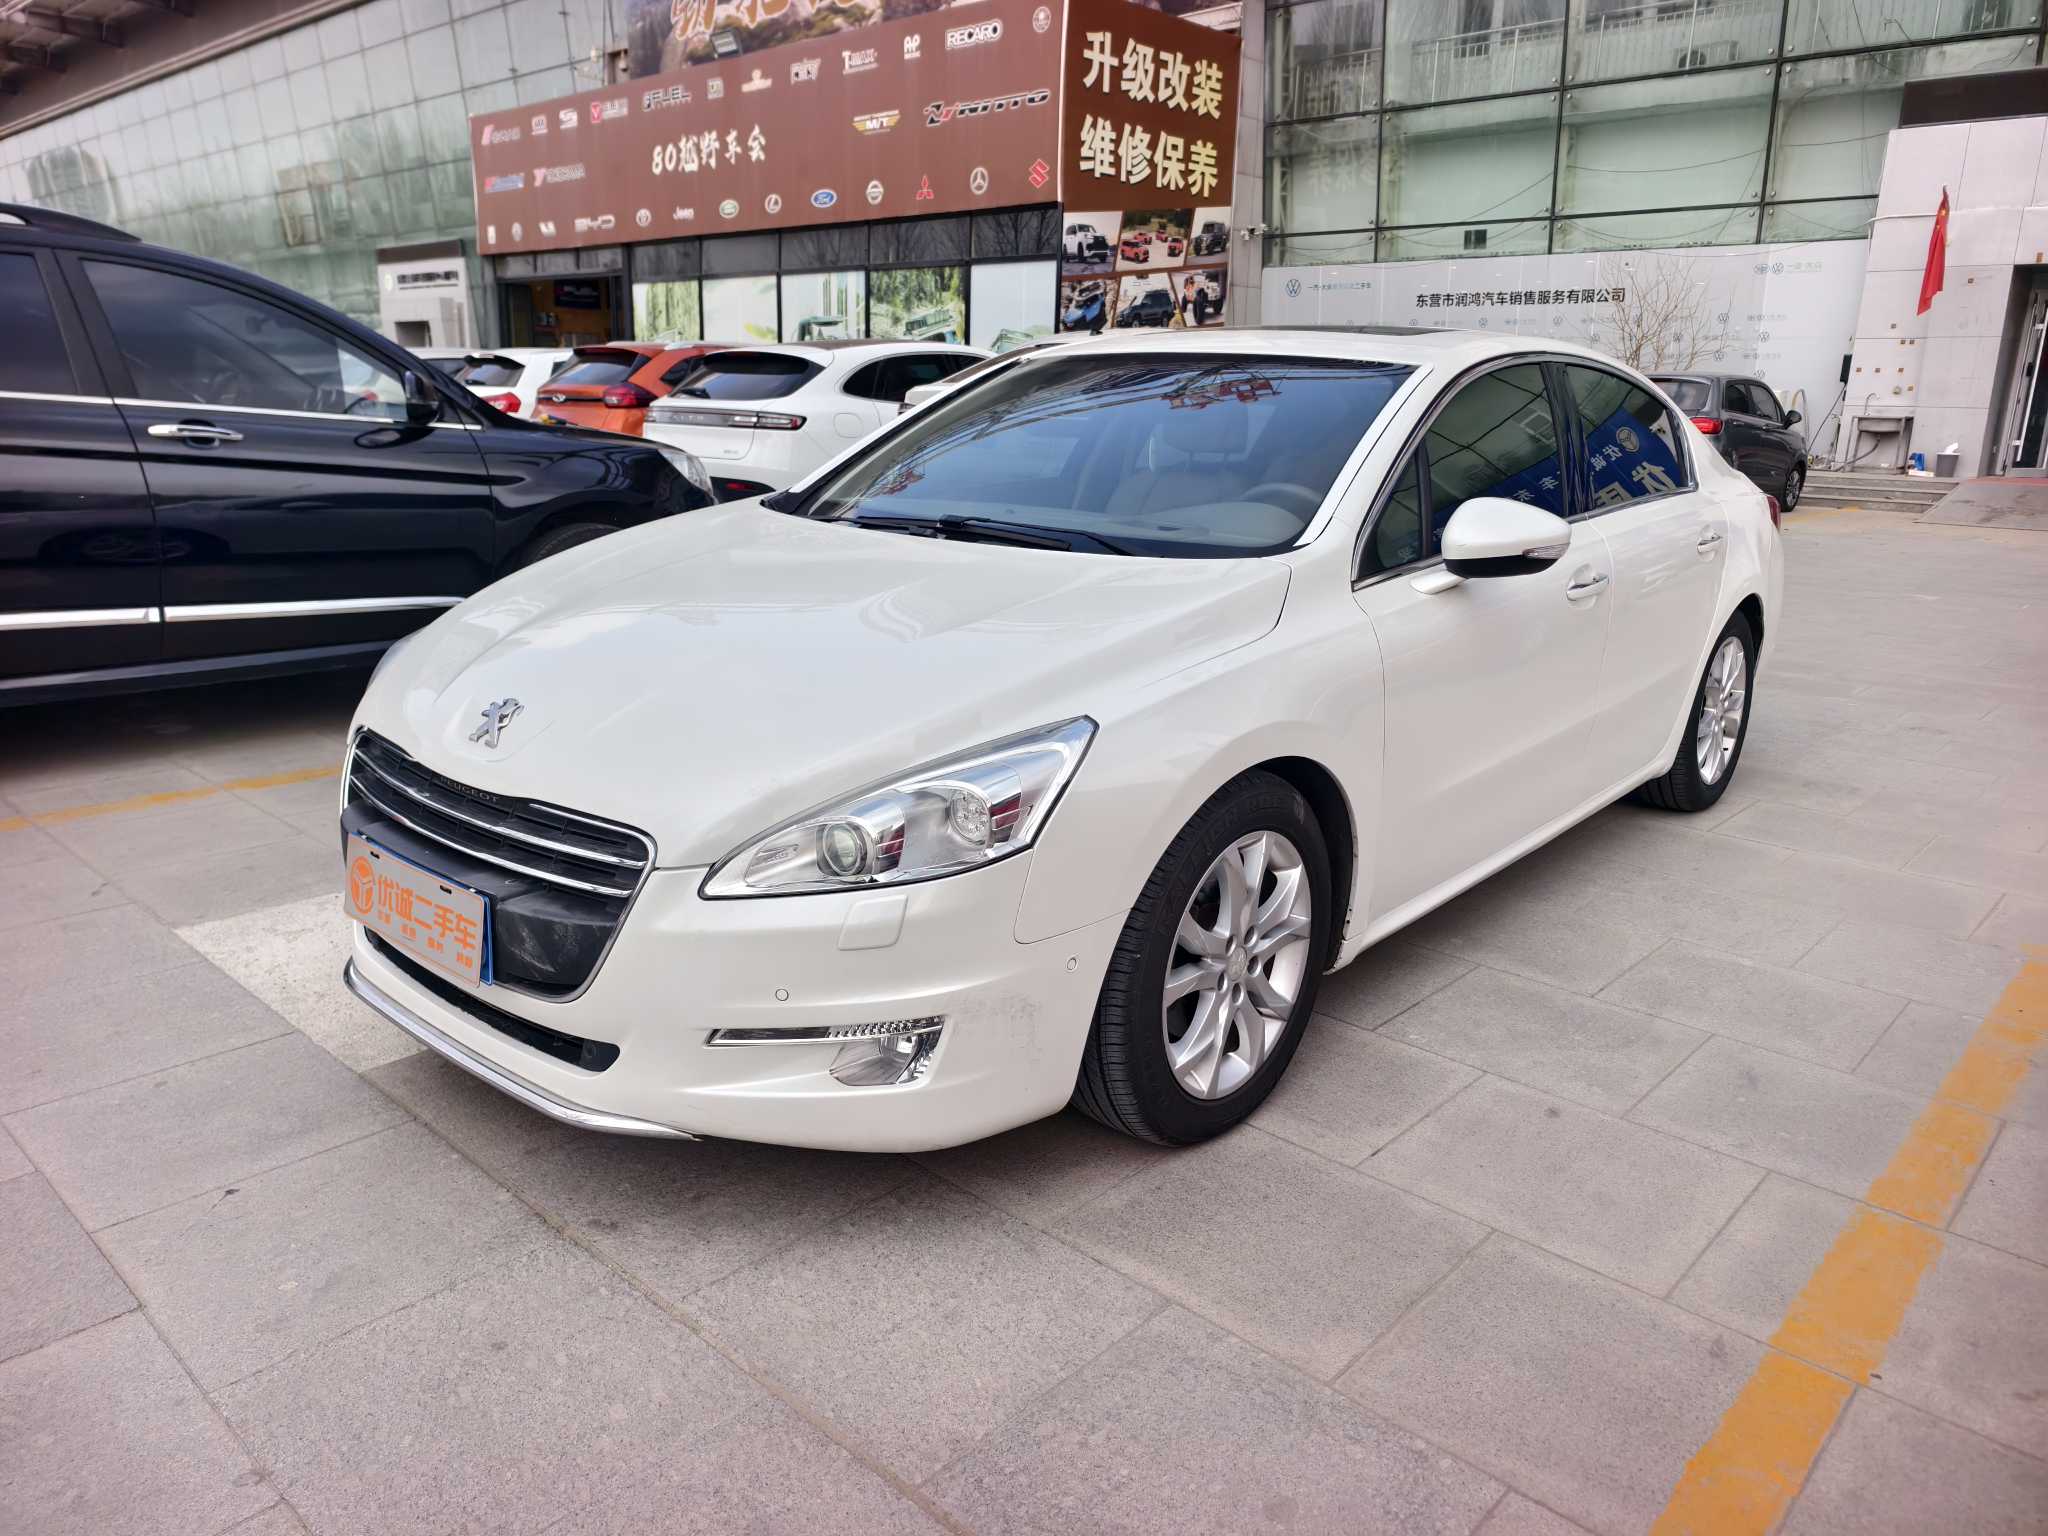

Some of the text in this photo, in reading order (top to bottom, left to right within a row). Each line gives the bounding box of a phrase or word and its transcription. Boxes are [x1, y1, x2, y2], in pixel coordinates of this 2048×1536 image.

[946, 20, 1002, 48] RECARO
[1083, 31, 1223, 119] 升级改装
[652, 123, 766, 175] 80越野车会
[1080, 114, 1218, 197] 维修保养
[574, 214, 616, 232] BYD
[1416, 288, 1625, 308] 东营市润鸿汽车销售服务有限公司
[377, 873, 478, 950] 优诚二手车
